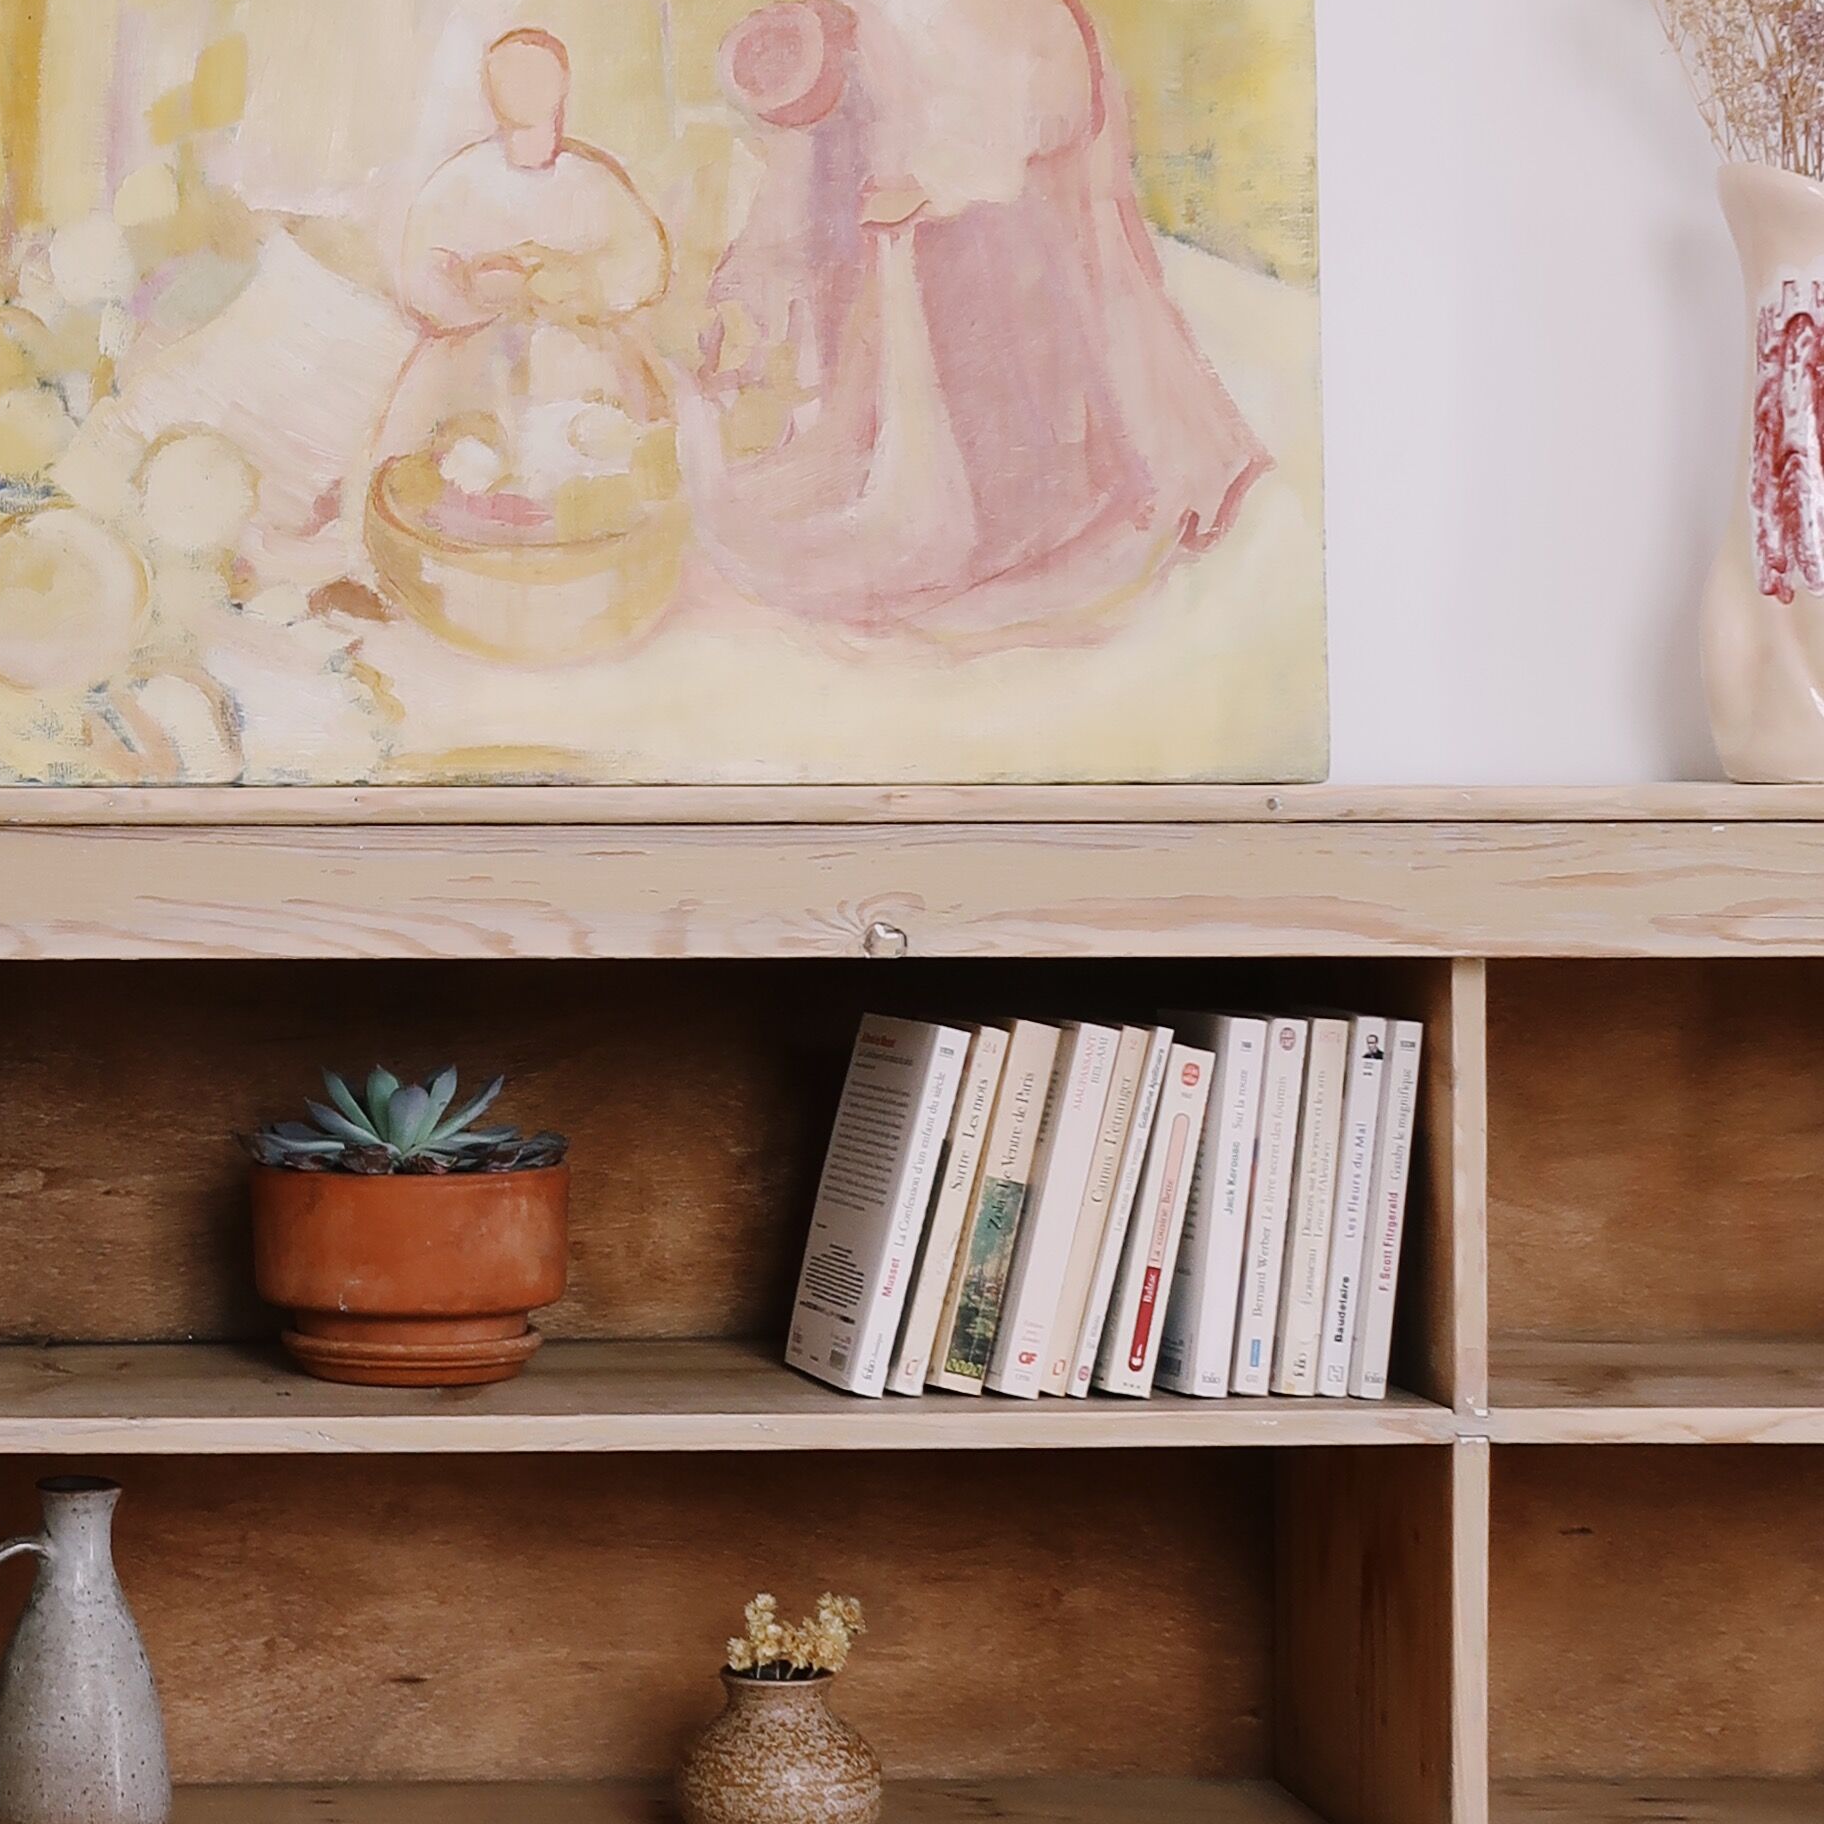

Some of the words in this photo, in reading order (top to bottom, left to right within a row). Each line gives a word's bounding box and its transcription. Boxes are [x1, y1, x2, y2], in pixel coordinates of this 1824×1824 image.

[1014, 1072, 1035, 1104] Paris
[1073, 1034, 1097, 1111] MAUPASSANT
[926, 1100, 940, 1115] du
[1233, 1099, 1246, 1109] la
[1271, 1075, 1287, 1119] fourmis
[1397, 1068, 1414, 1129] magnifique
[1011, 1106, 1027, 1124] de
[1231, 1111, 1245, 1130] Sur
[1269, 1121, 1283, 1141] des
[920, 1116, 936, 1149] enfant
[950, 1150, 970, 1192] Sartre
[961, 1114, 980, 1139] Les
[972, 1078, 989, 1112] mots
[1000, 1126, 1022, 1167] Ventre
[1354, 1122, 1367, 1149] Mal
[1392, 1131, 1405, 1141] le
[1226, 1141, 1241, 1187] Kerouac
[1269, 1143, 1280, 1176] secret
[1351, 1152, 1364, 1169] du
[1389, 1144, 1407, 1181] Gatsby
[1090, 1155, 1116, 1203] Camus
[1262, 1179, 1277, 1203] livre
[1346, 1173, 1362, 1213] Fleurs
[897, 1176, 921, 1232] Confession
[986, 1198, 1006, 1231] Zola
[1223, 1189, 1236, 1215] Jack
[1344, 1217, 1358, 1239] Les
[1382, 1191, 1399, 1248] Fitzgerald
[893, 1234, 907, 1248] La
[1256, 1226, 1272, 1269] Werber
[881, 1257, 900, 1298] Musset
[1378, 1249, 1393, 1280] Scott
[1251, 1271, 1267, 1317] Bernard
[1333, 1276, 1350, 1343] Baudelaire
